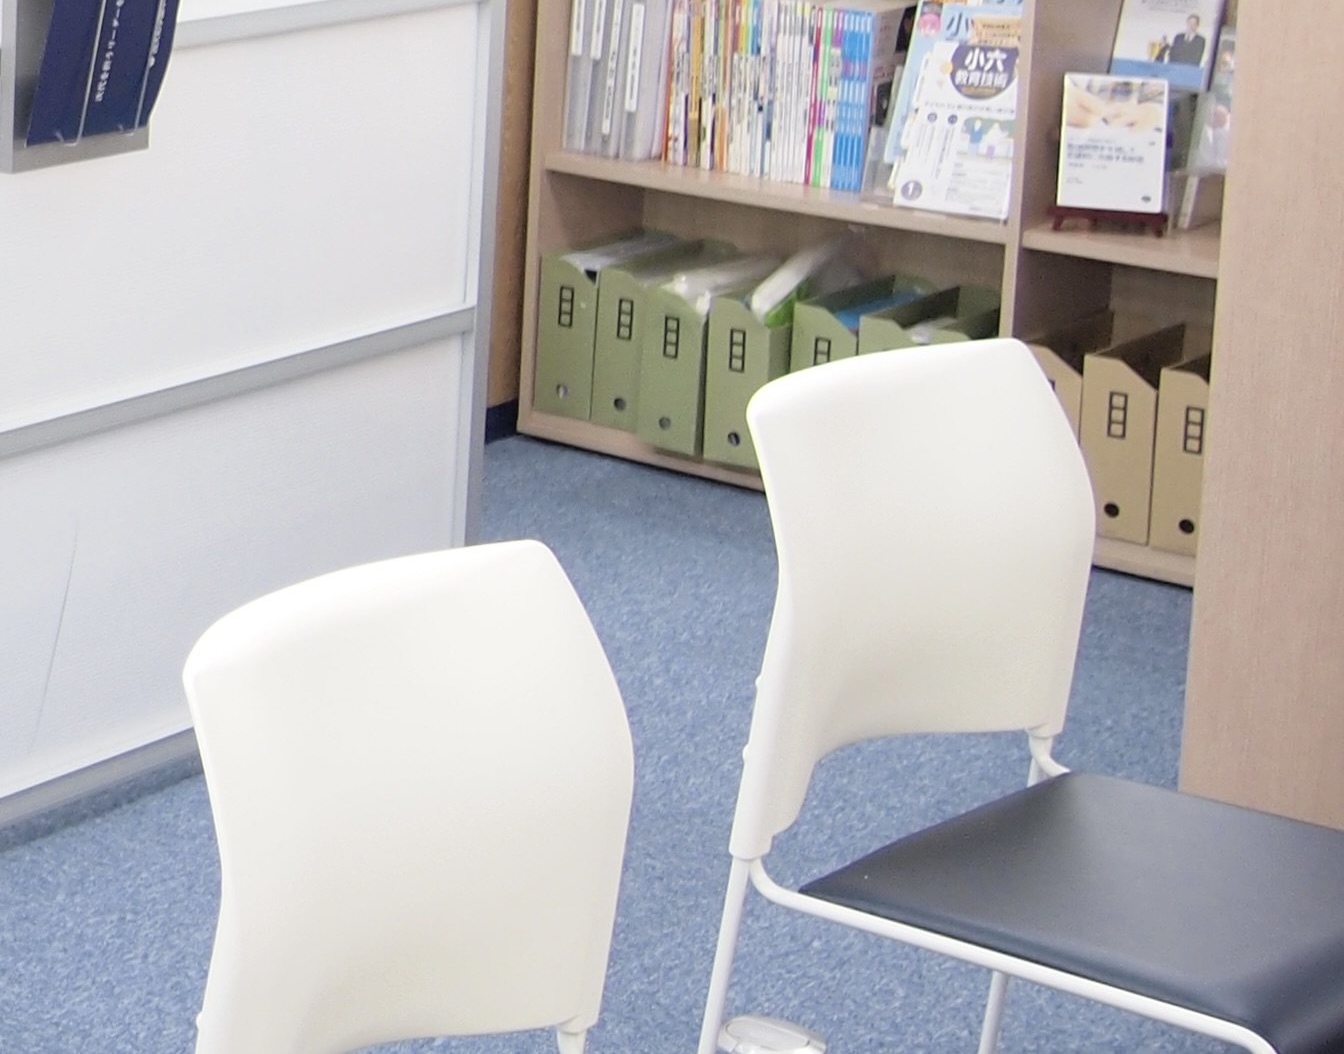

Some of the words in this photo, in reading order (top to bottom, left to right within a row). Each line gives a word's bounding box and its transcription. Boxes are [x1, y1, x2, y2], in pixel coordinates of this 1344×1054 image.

[964, 47, 1007, 72] 小六
[954, 70, 1009, 89] 教育技術
